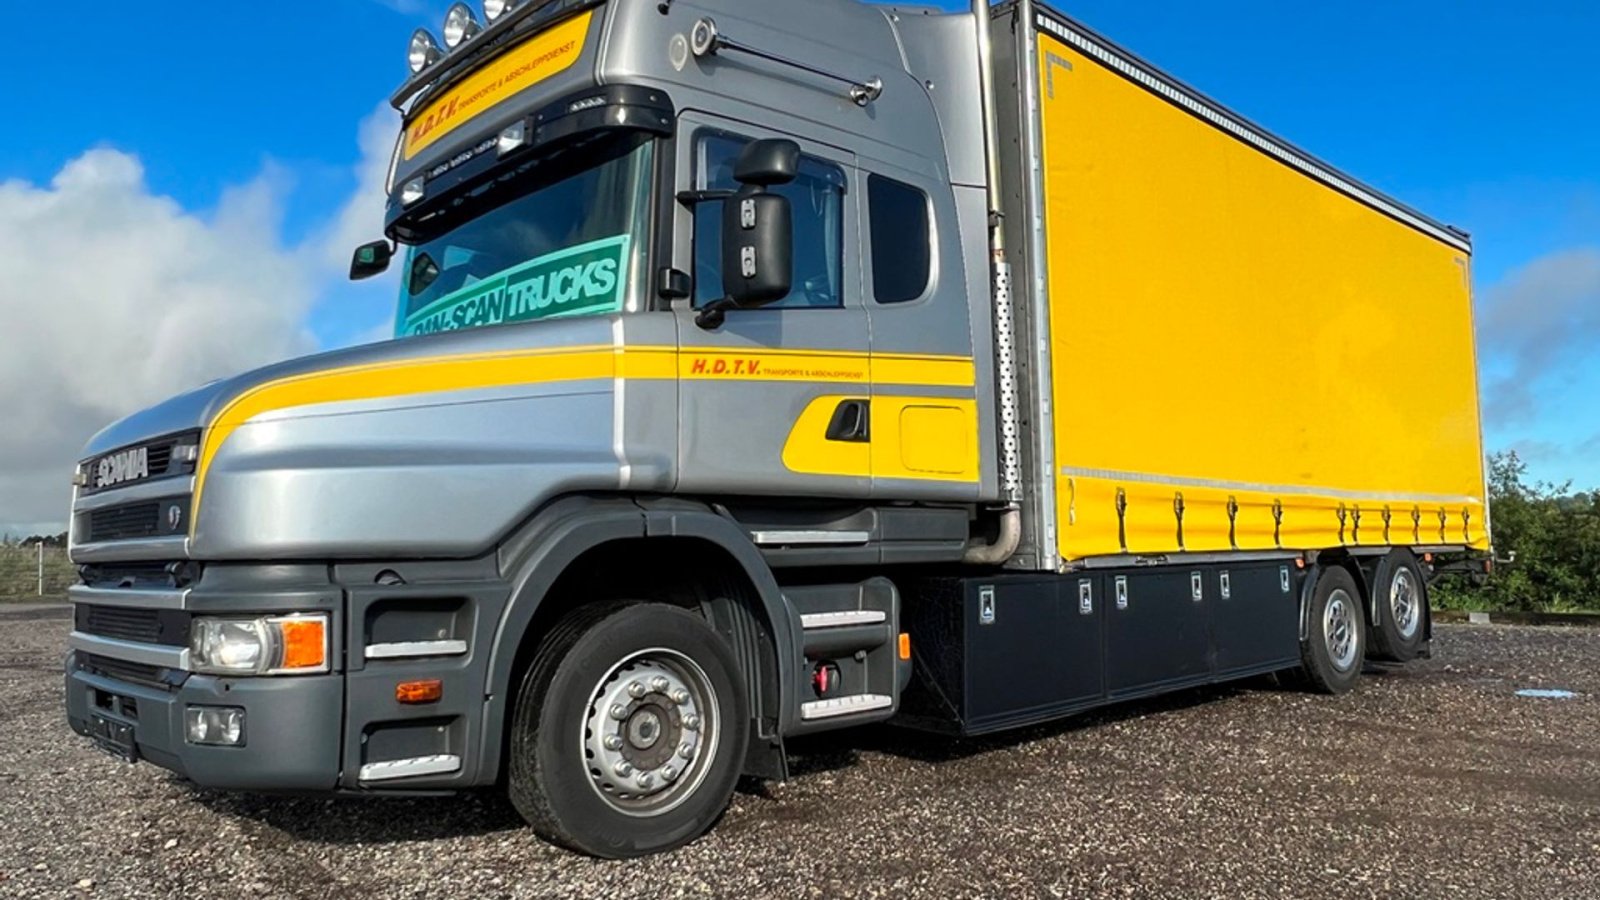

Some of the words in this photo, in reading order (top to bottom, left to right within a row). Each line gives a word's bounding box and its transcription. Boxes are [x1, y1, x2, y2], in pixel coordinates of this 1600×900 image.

[507, 258, 617, 317] TRUCKS
[691, 359, 761, 375] H.D.T.V.
[97, 447, 148, 487] SCANIA
